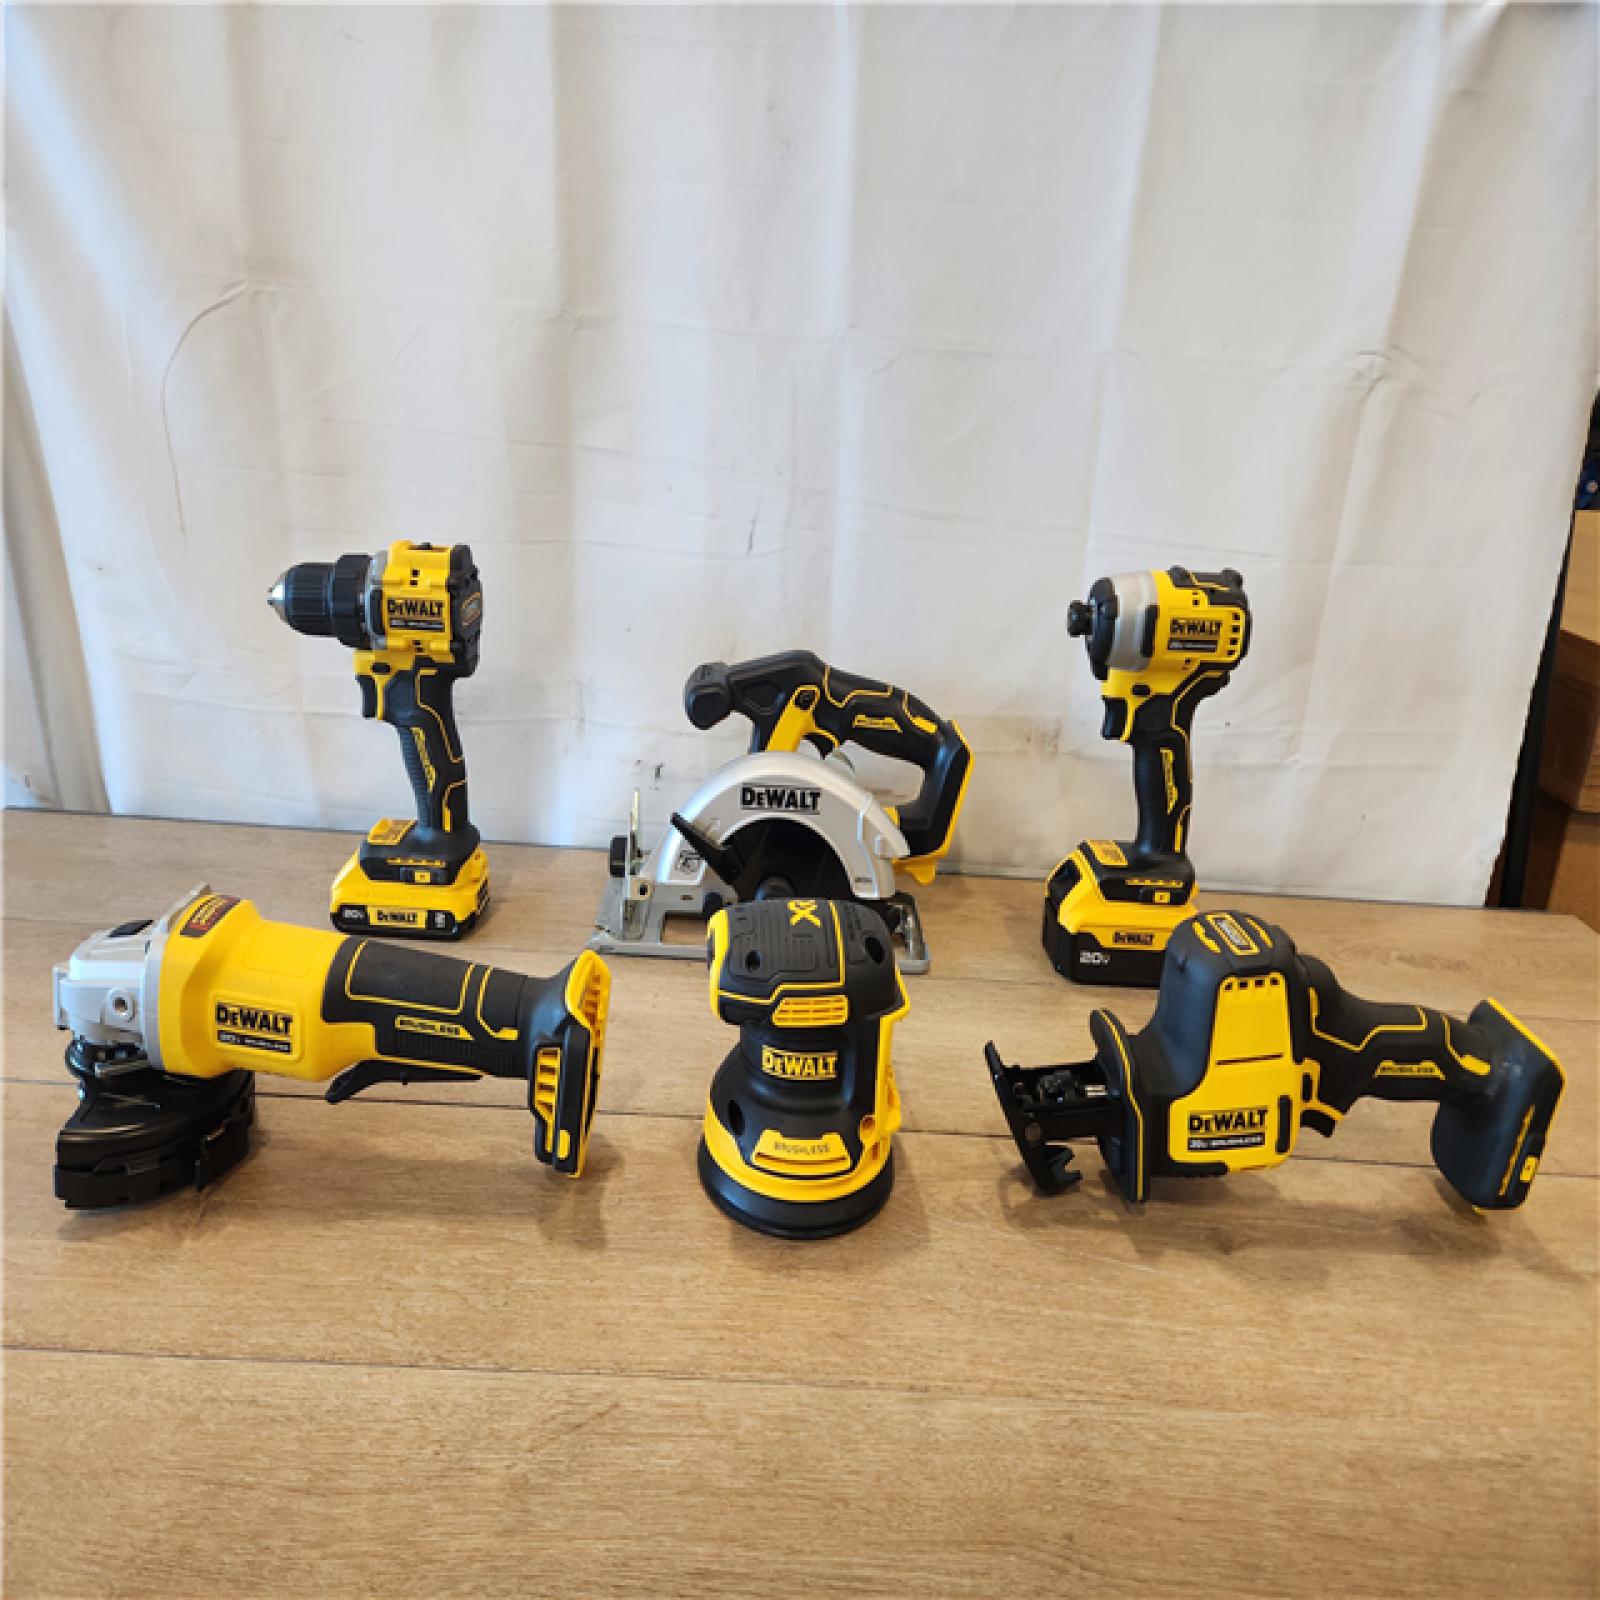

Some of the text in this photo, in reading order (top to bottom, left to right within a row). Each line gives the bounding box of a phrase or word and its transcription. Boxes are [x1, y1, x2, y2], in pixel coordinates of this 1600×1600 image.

[741, 786, 820, 811] DEWALT
[215, 1002, 294, 1036] DEWALT
[761, 1045, 838, 1079] DEWALT
[1188, 1108, 1268, 1133] DEWALT
